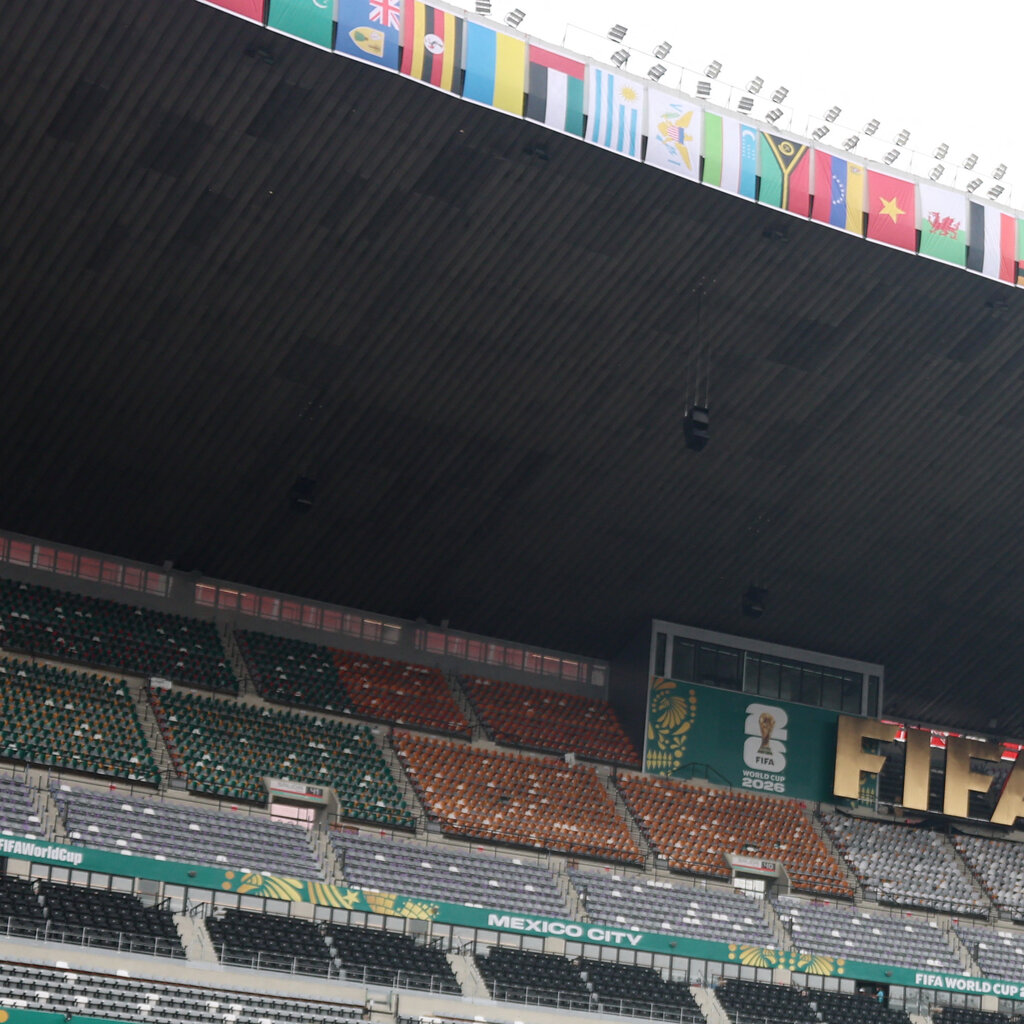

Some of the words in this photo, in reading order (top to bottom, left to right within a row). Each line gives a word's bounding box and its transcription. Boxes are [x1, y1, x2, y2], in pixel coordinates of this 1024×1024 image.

[755, 756, 775, 766] FIFA
[742, 769, 770, 780] WORLD
[770, 774, 786, 782] CUP
[741, 777, 786, 793] 2026
[487, 913, 583, 938] MEXICO
[587, 928, 643, 946] CITY
[915, 973, 943, 988] FIFA
[944, 977, 991, 993] WORLD
[992, 983, 1018, 997] CUP
